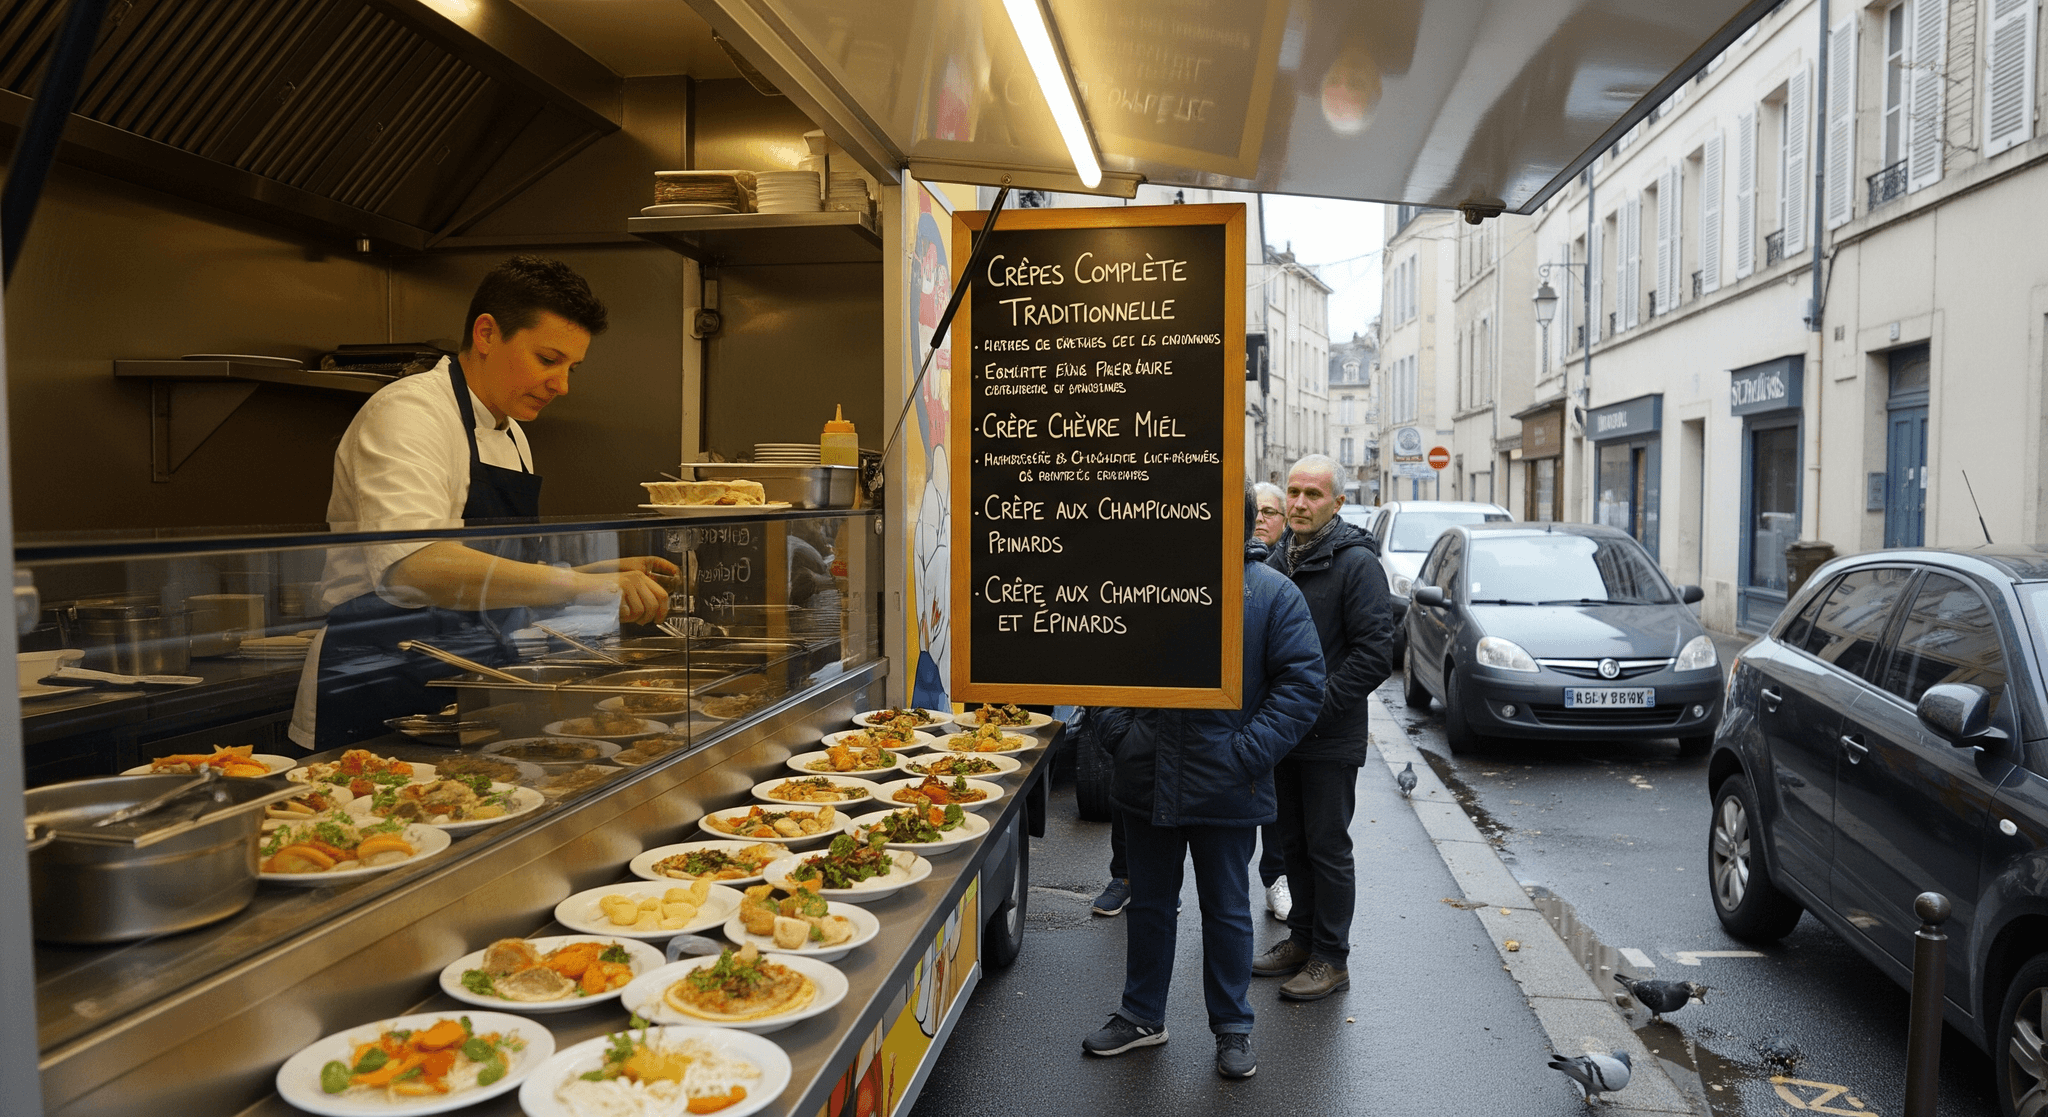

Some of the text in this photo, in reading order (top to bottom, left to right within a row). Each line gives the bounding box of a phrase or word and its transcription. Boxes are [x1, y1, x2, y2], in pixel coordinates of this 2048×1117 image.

[987, 251, 1188, 287] CRÊPES COMPLÈTE
[998, 296, 1176, 327] TRADITIONNELLE
[1048, 411, 1120, 439] CHÈVRE
[1055, 501, 1089, 520] AUX
[984, 575, 1213, 606] CRÊPE AUX CHAMPIGNONS
[998, 603, 1127, 635] ET ÉPINARDS
